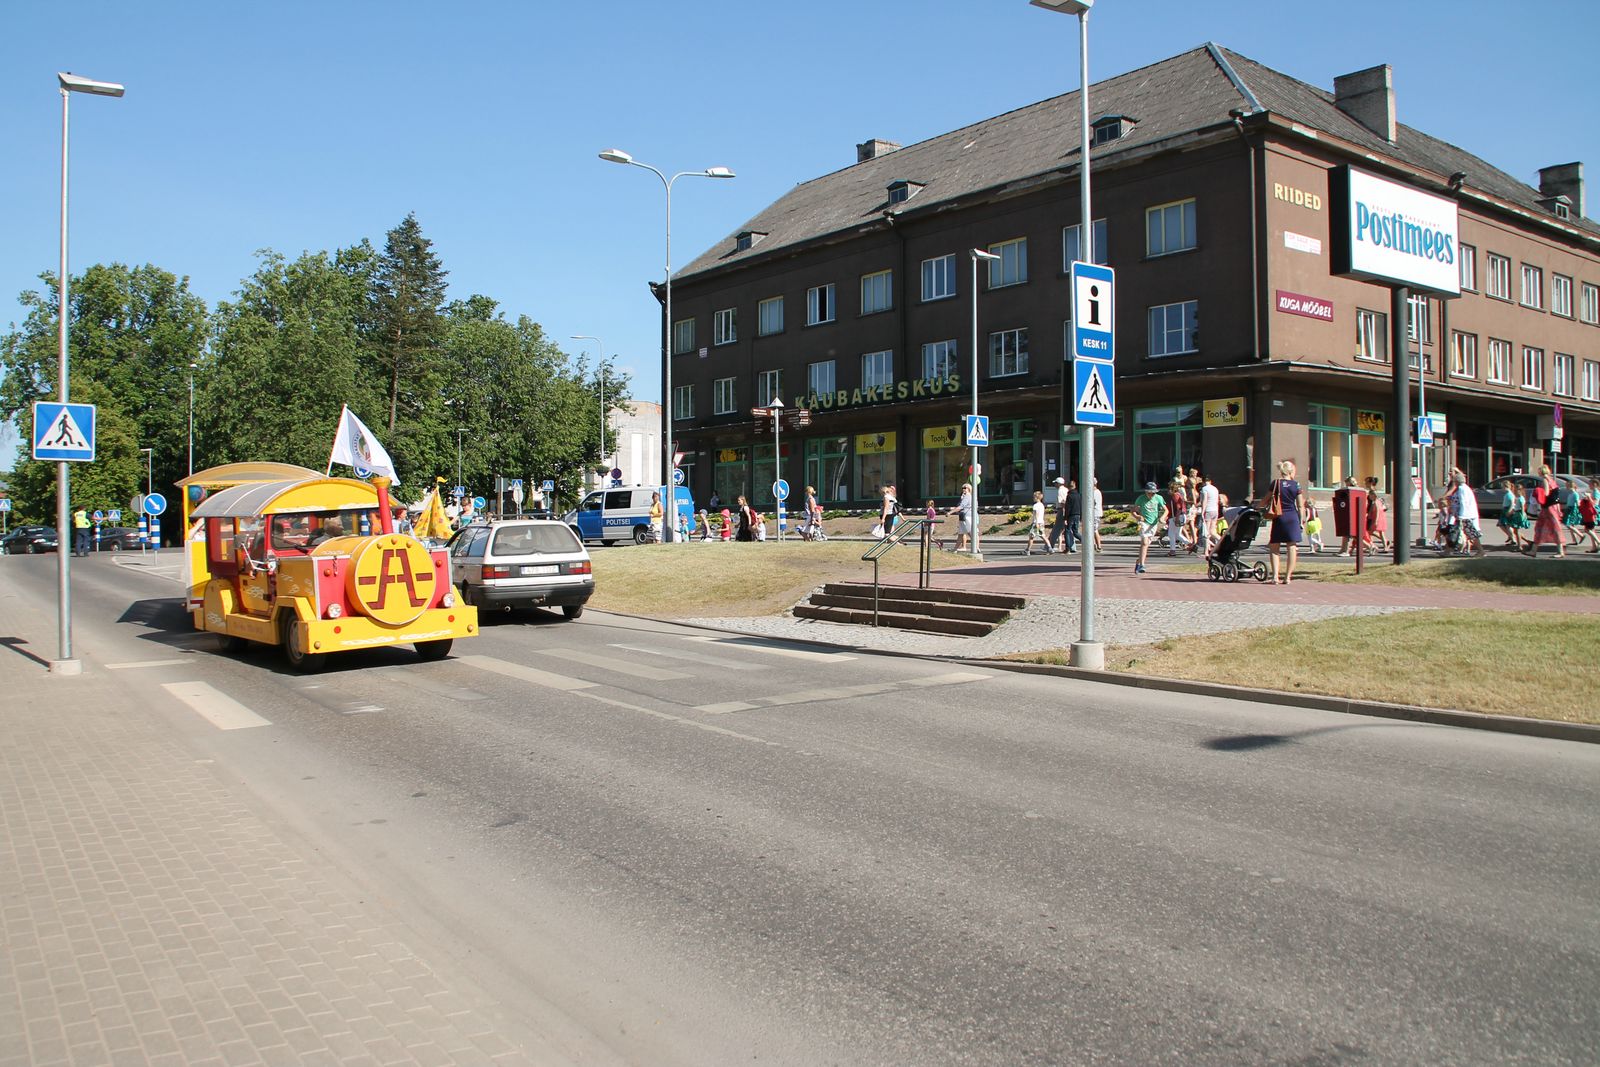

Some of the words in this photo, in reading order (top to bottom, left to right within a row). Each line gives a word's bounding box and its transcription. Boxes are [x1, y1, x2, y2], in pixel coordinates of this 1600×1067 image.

[1274, 183, 1321, 211] RIIDED
[1355, 201, 1453, 265] Postimees
[1279, 296, 1300, 311] KUGA
[1082, 338, 1100, 350] KESK
[1100, 341, 1107, 350] 11
[795, 374, 961, 411] KAUBAKESKUS
[1206, 408, 1228, 419] Tootsi
[606, 518, 631, 526] POLITSEI
